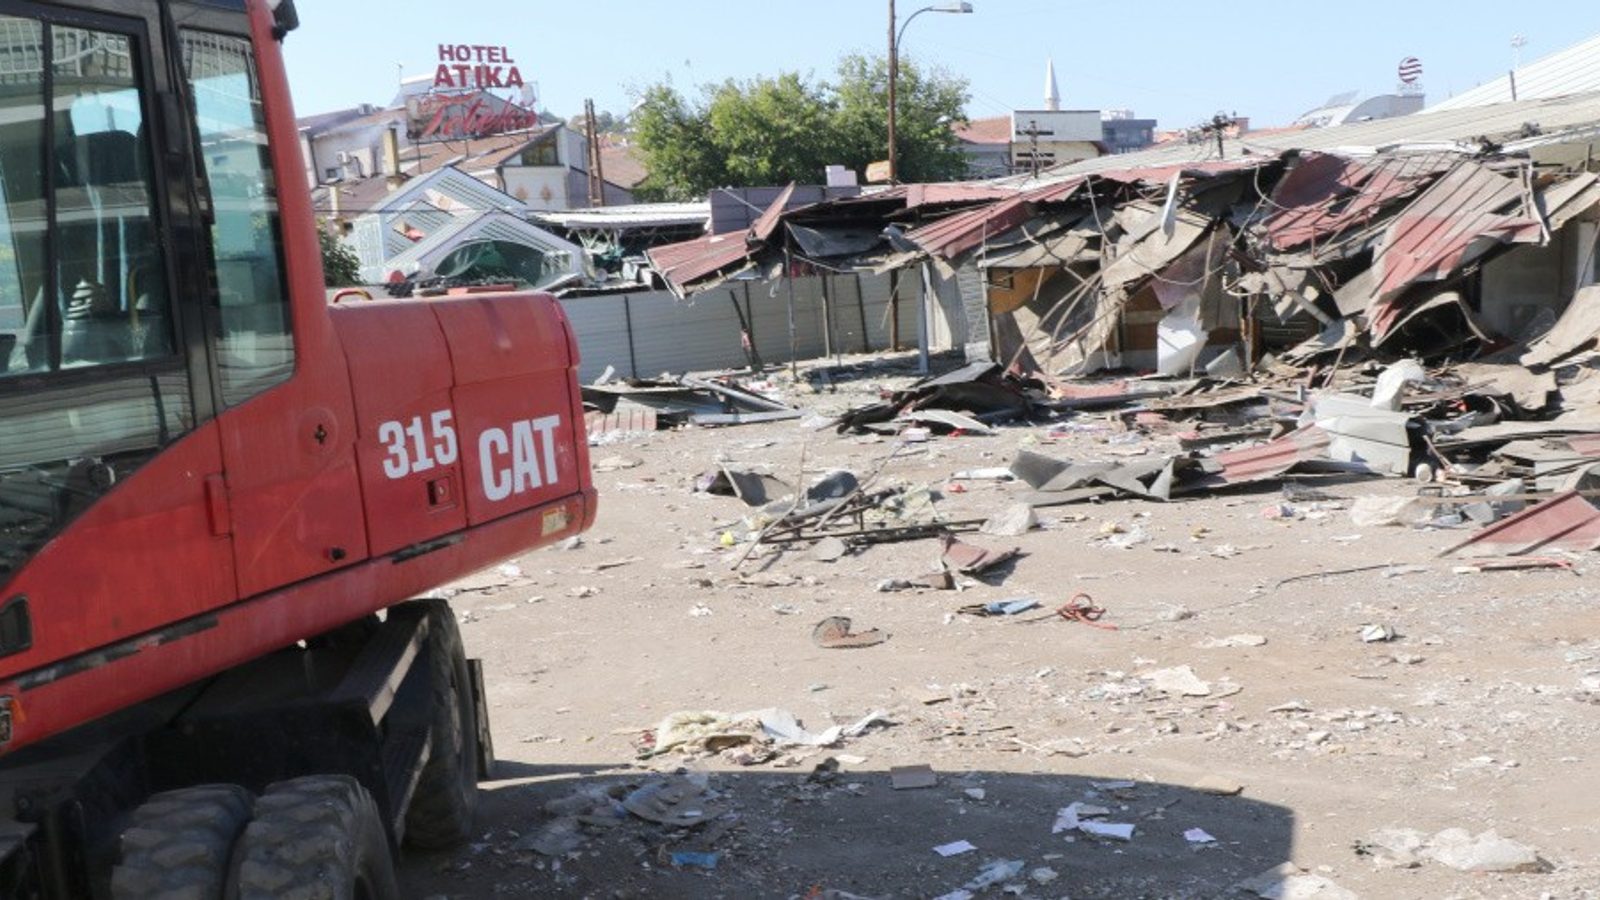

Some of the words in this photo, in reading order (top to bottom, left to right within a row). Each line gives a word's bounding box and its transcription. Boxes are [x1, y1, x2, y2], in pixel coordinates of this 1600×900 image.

[434, 64, 523, 88] ATIKA
[438, 44, 514, 63] HOTEL
[378, 409, 457, 479] 315
[478, 414, 560, 501] CAT
